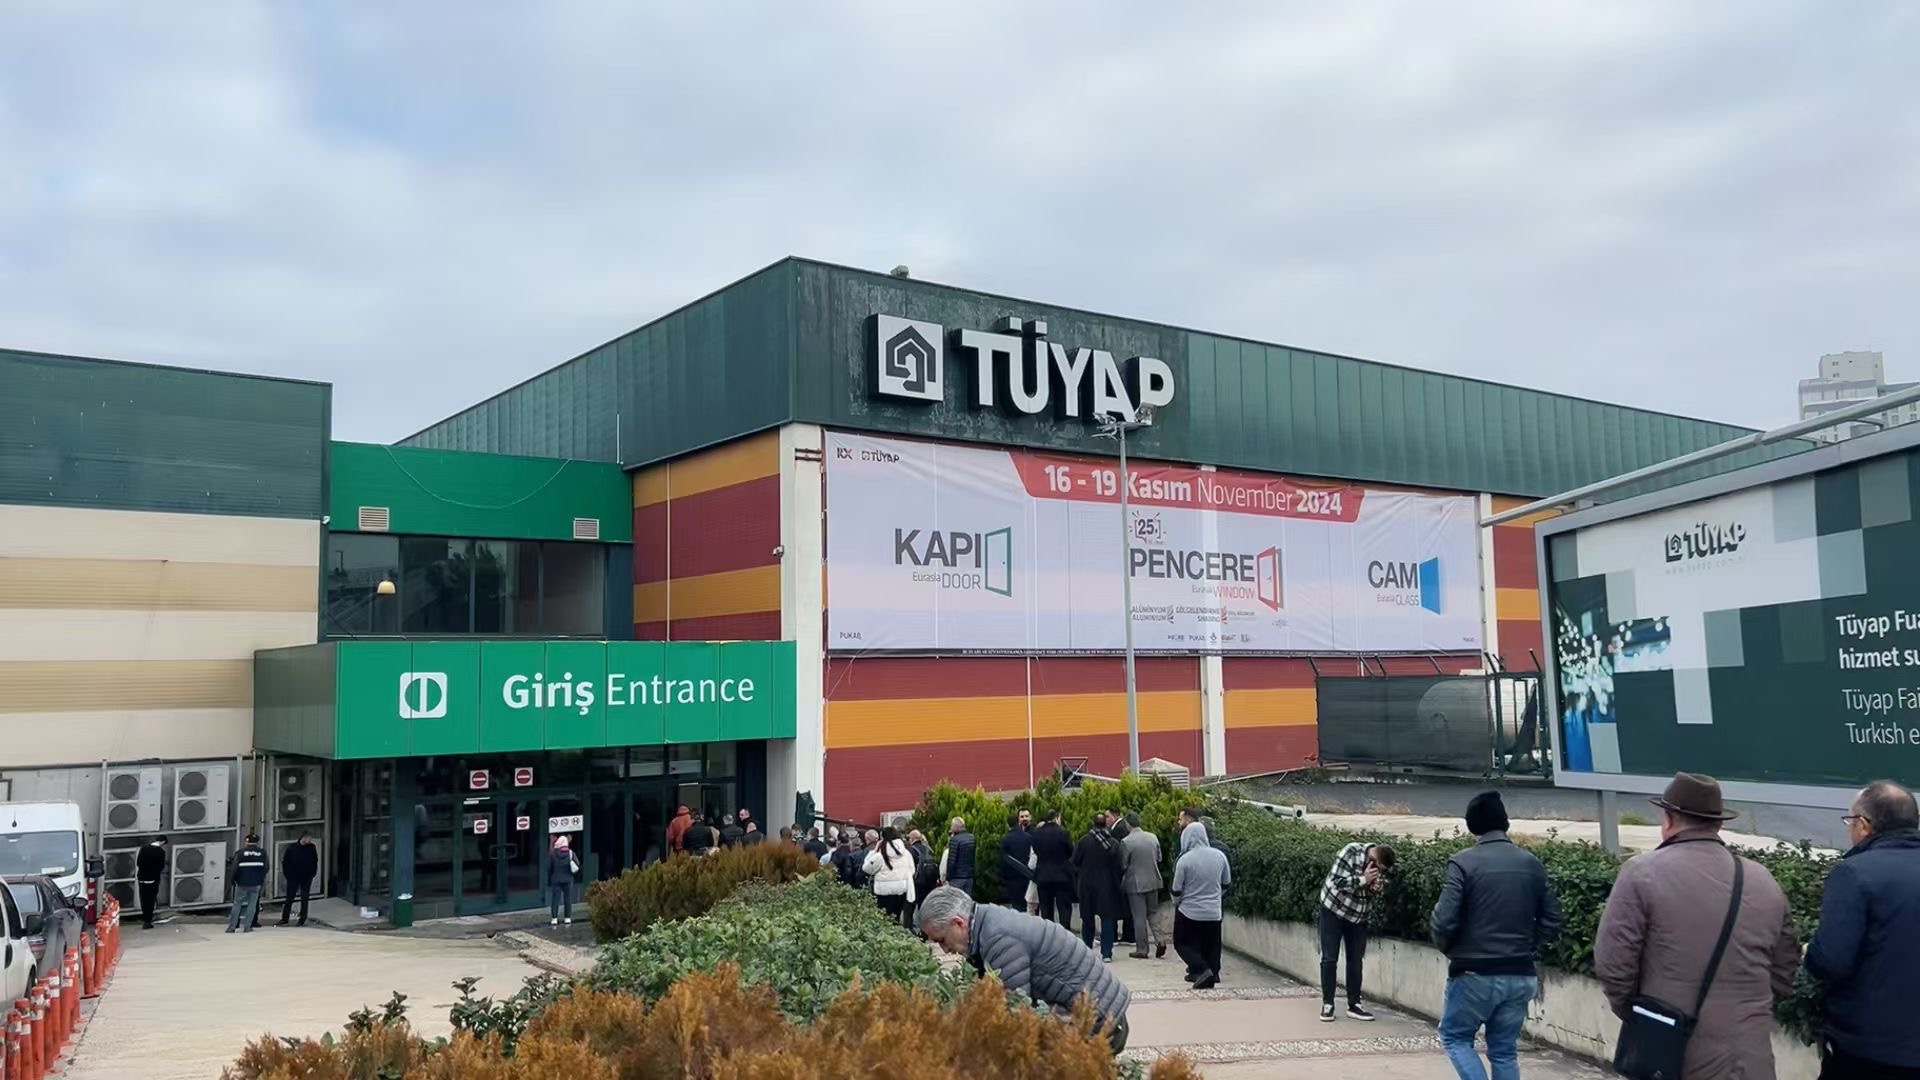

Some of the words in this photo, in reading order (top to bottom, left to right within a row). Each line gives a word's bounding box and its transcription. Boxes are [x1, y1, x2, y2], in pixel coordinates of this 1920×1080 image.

[958, 316, 1175, 426] TÜYAP
[1044, 465, 1071, 493] 16
[1091, 469, 1116, 496] 19
[1126, 471, 1192, 502] Kasım
[1197, 477, 1292, 512] November
[1296, 488, 1343, 516] 2024
[895, 528, 981, 568] KAPI
[1683, 521, 1746, 559] TÜYAP
[1130, 548, 1255, 582] PENCERE
[1368, 560, 1418, 589] CAM
[913, 571, 941, 582] Eurasia
[942, 573, 981, 589] DOOR
[1213, 586, 1255, 599] WINDOW
[1835, 613, 1890, 639] Tüyap
[1839, 647, 1901, 669] hizmet
[502, 672, 595, 716] Giriş
[607, 673, 755, 706] Entrance
[1842, 688, 1893, 715] Tüyap
[1845, 721, 1905, 744] Turkish
